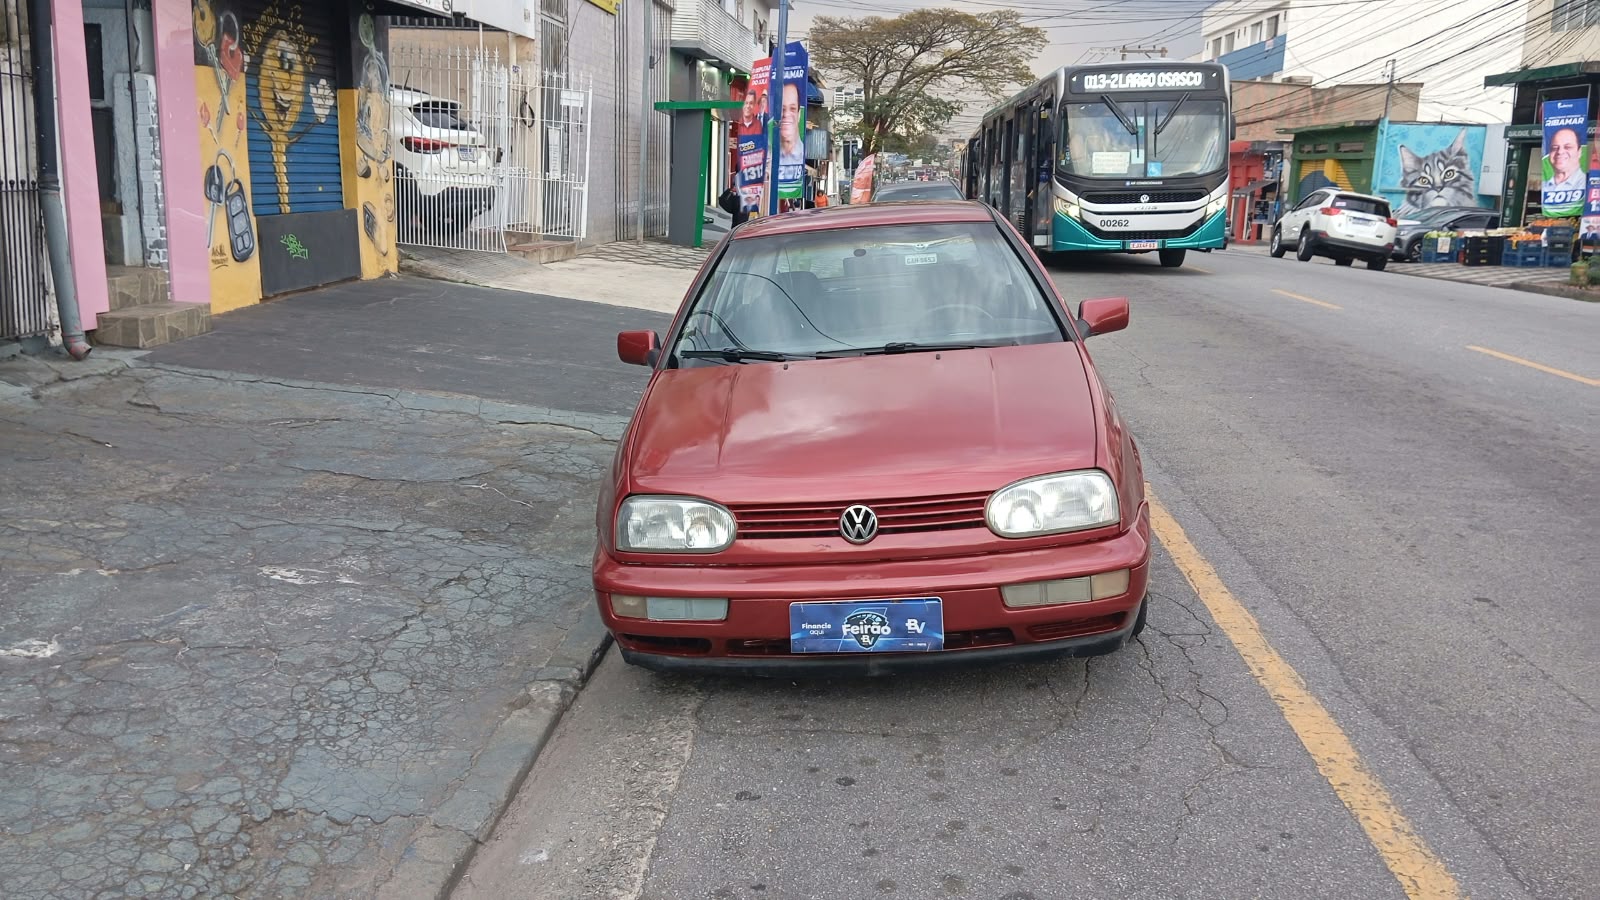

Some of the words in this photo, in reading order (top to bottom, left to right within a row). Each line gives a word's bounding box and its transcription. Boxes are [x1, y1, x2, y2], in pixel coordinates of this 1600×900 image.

[1157, 71, 1202, 87] OSASCO
[1545, 118, 1584, 126] RIBAMAR
[1544, 190, 1582, 204] 2019
[1100, 219, 1129, 227] 00262
[801, 622, 831, 630] Financie
[842, 620, 891, 636] Feirão
